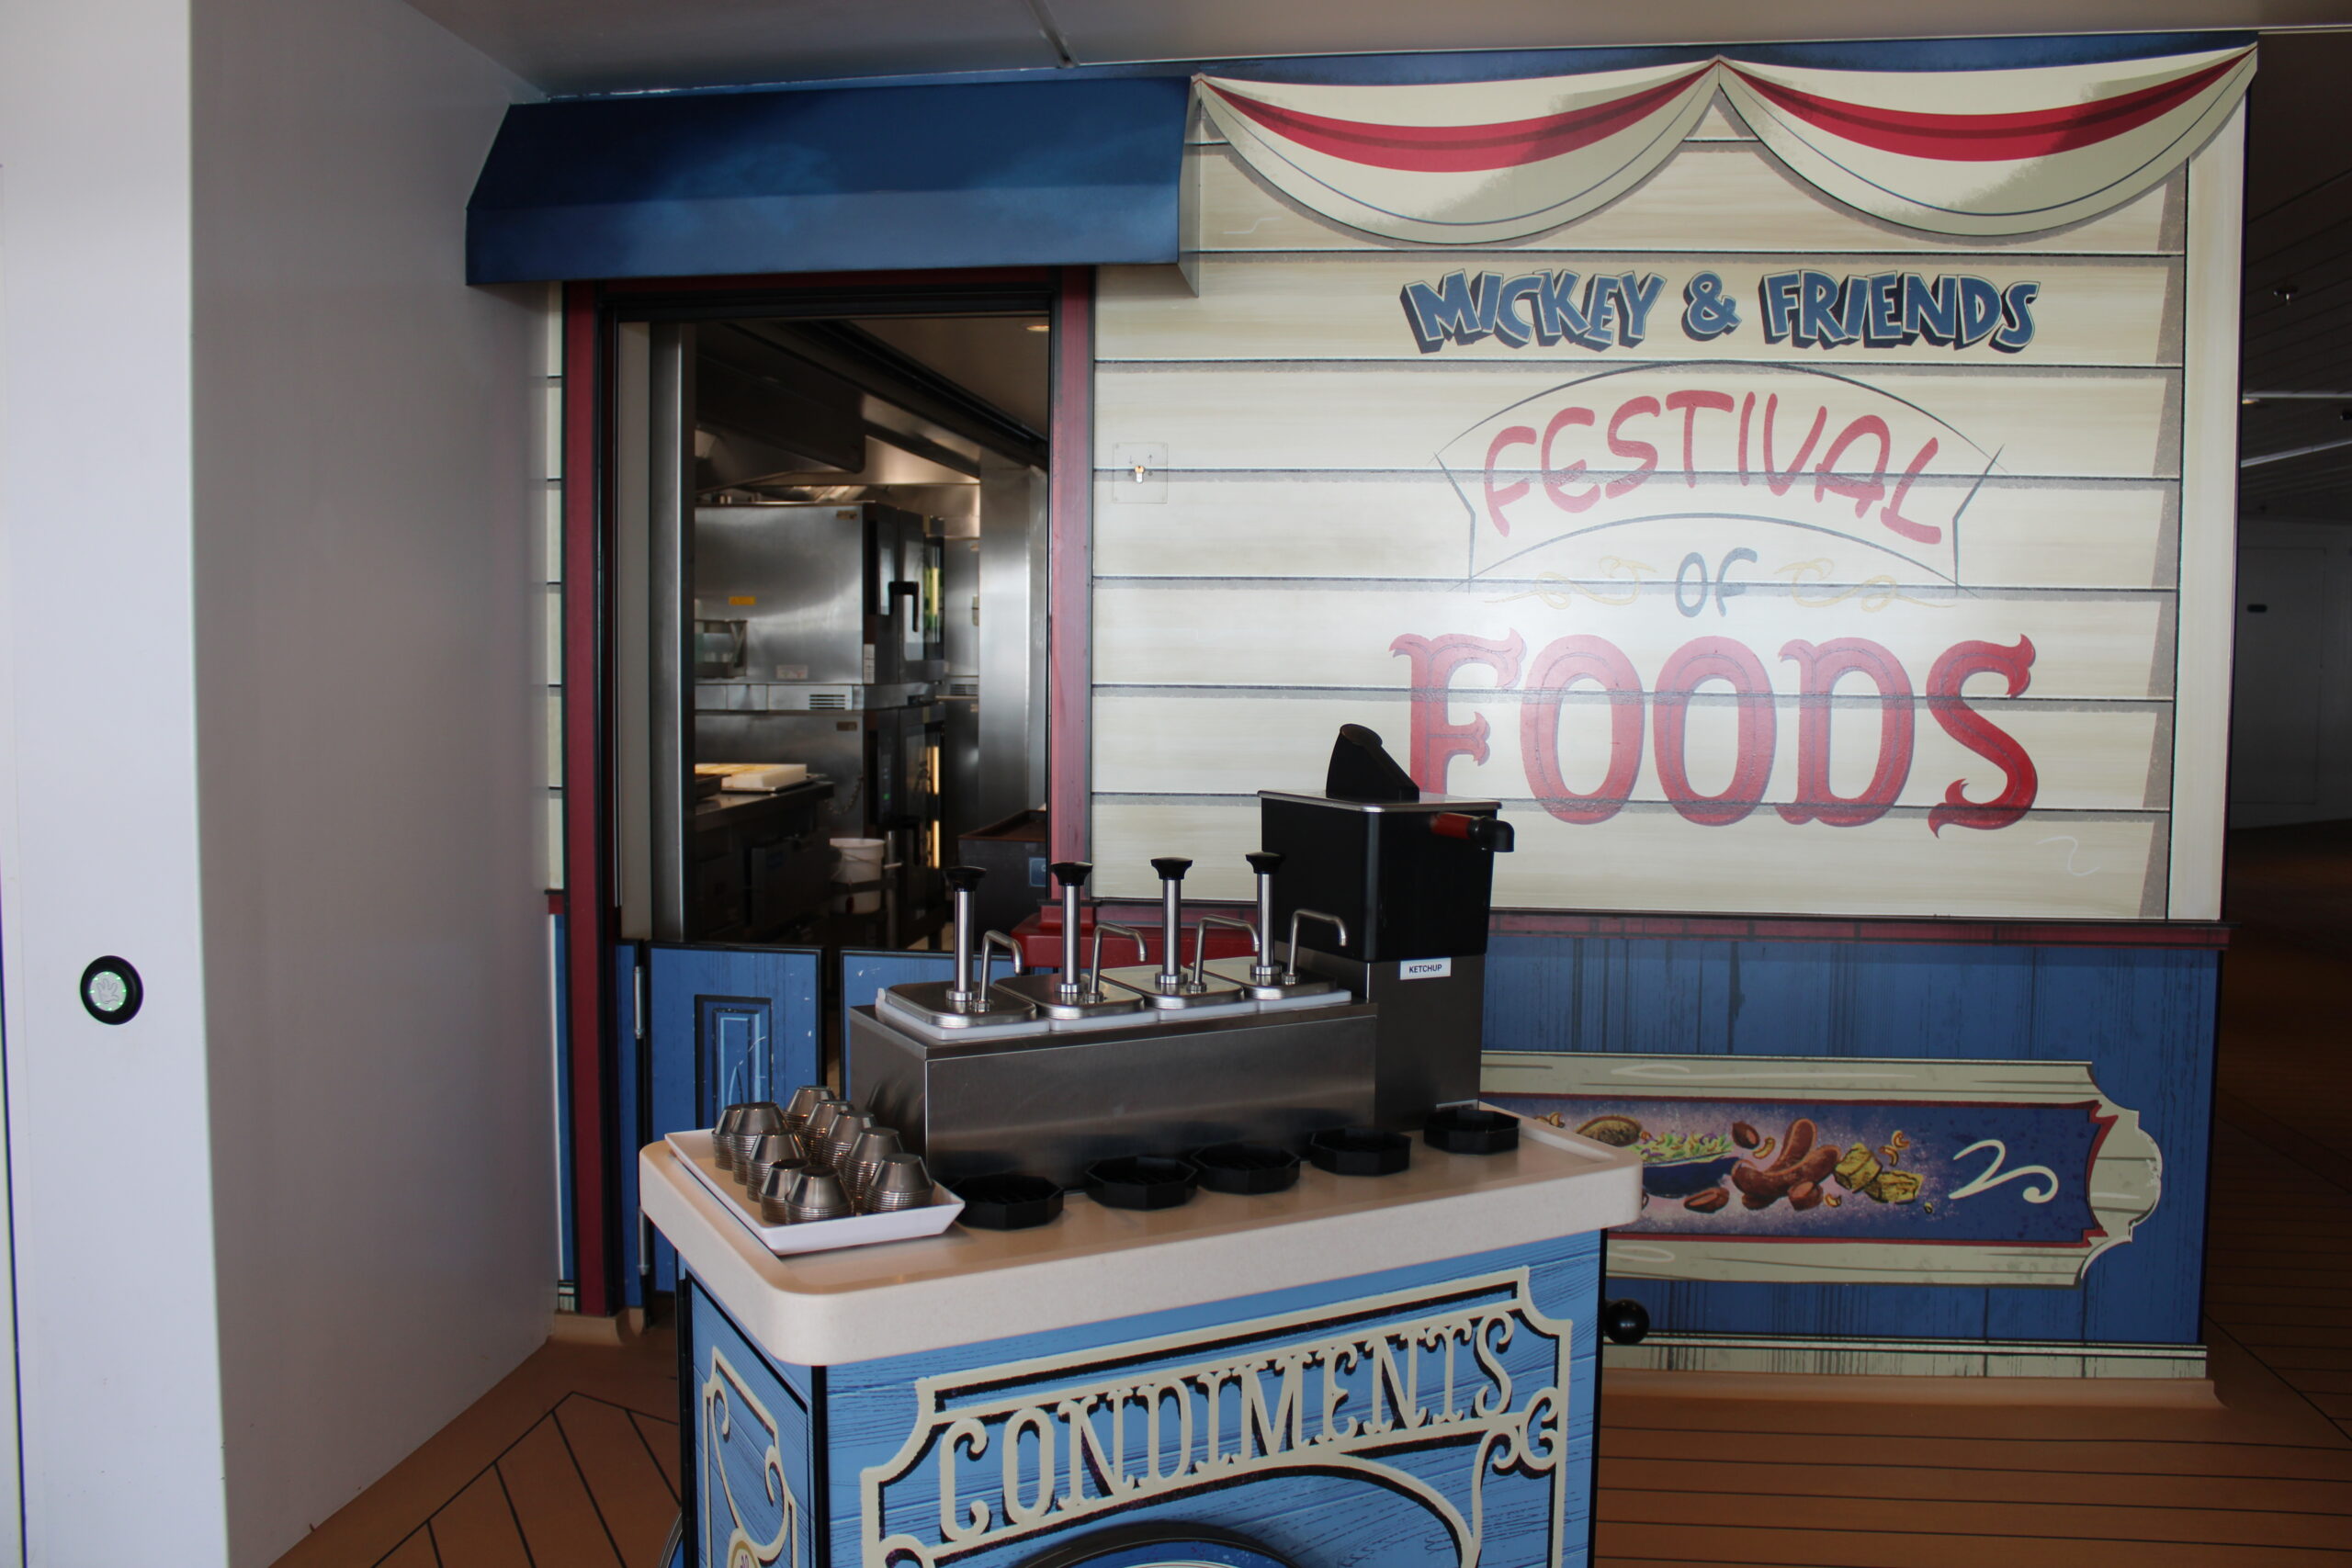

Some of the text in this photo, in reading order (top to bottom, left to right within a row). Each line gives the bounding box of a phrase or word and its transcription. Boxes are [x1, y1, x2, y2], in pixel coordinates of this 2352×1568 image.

[1400, 268, 2041, 354] MICKEY & FRIENDS
[1483, 389, 1942, 545] FESTIVAL
[1675, 547, 1758, 617] OF
[1388, 627, 2039, 839] FOODS
[1408, 964, 1442, 974] KETCHUP
[940, 1309, 1515, 1543] CONDIMENTS
